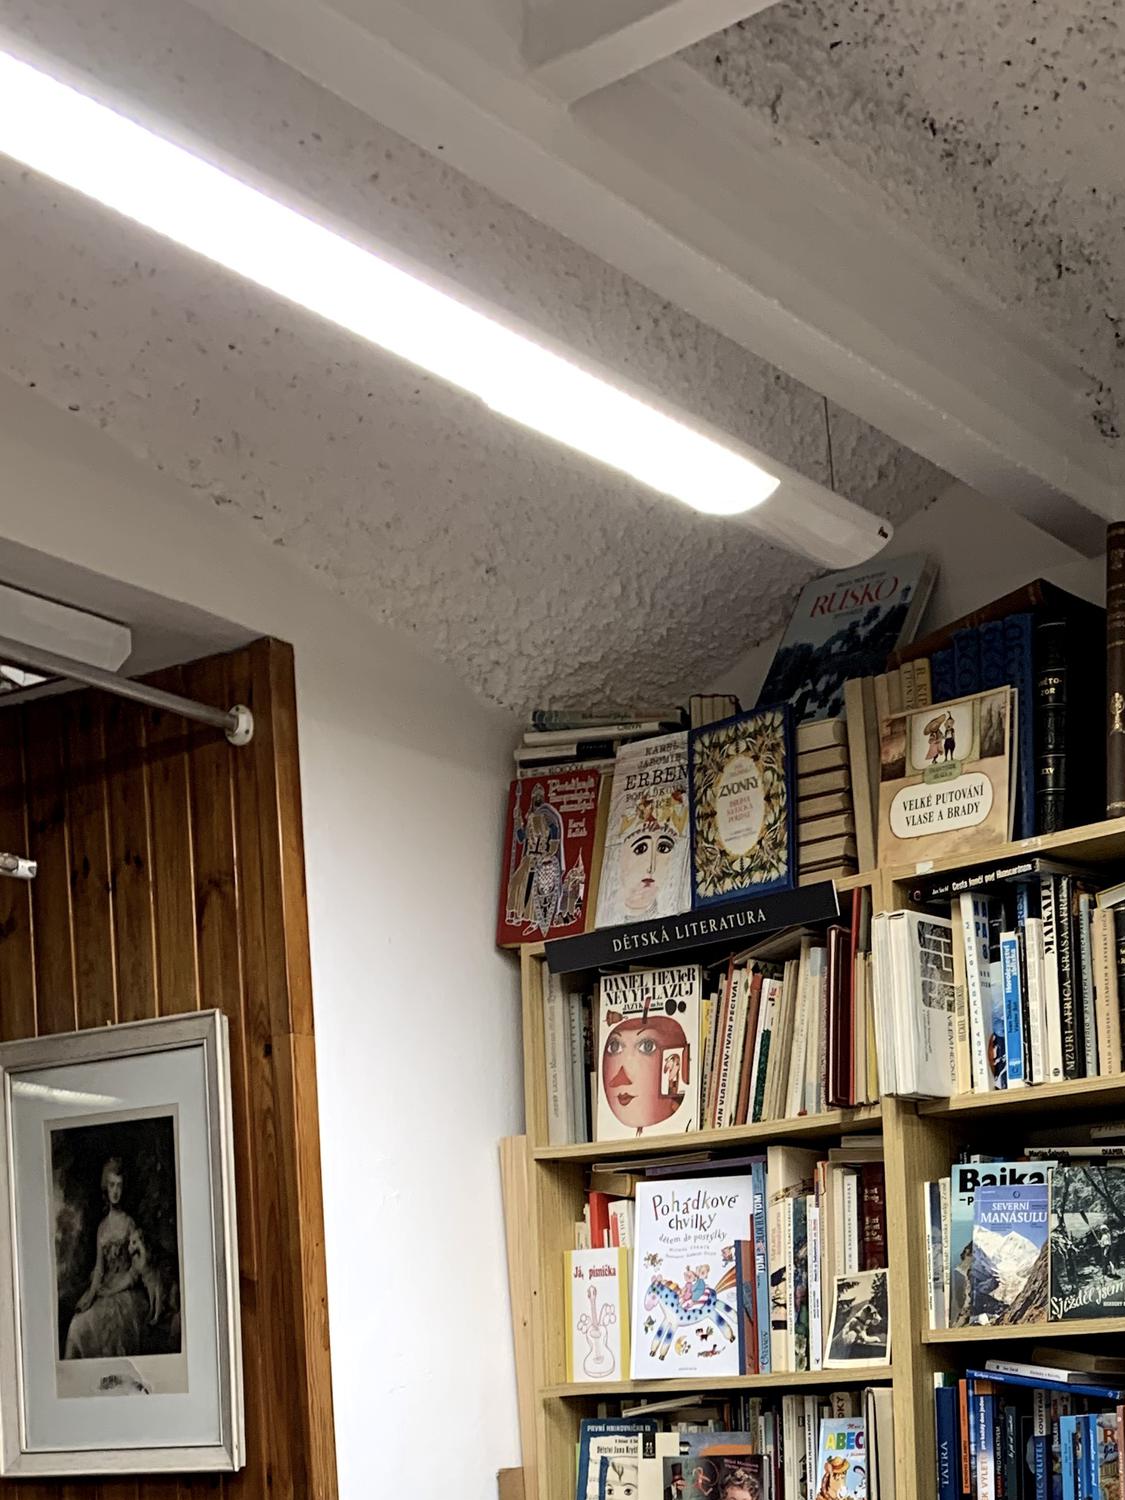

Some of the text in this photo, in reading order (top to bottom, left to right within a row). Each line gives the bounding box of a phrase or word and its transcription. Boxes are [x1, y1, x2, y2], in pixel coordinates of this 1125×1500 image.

[624, 764, 688, 791] ERBEN
[903, 784, 984, 812] VELKÉ PUTOVÁNÍ
[905, 802, 980, 827] VLASE A BRADY
[613, 908, 767, 952] DĚTSKÁ LITERATURA
[652, 1190, 738, 1221] Pohádkové
[992, 1200, 1029, 1212] SEVERNÍ
[668, 1213, 716, 1232] chvilky
[940, 1441, 950, 1488] TATRA
